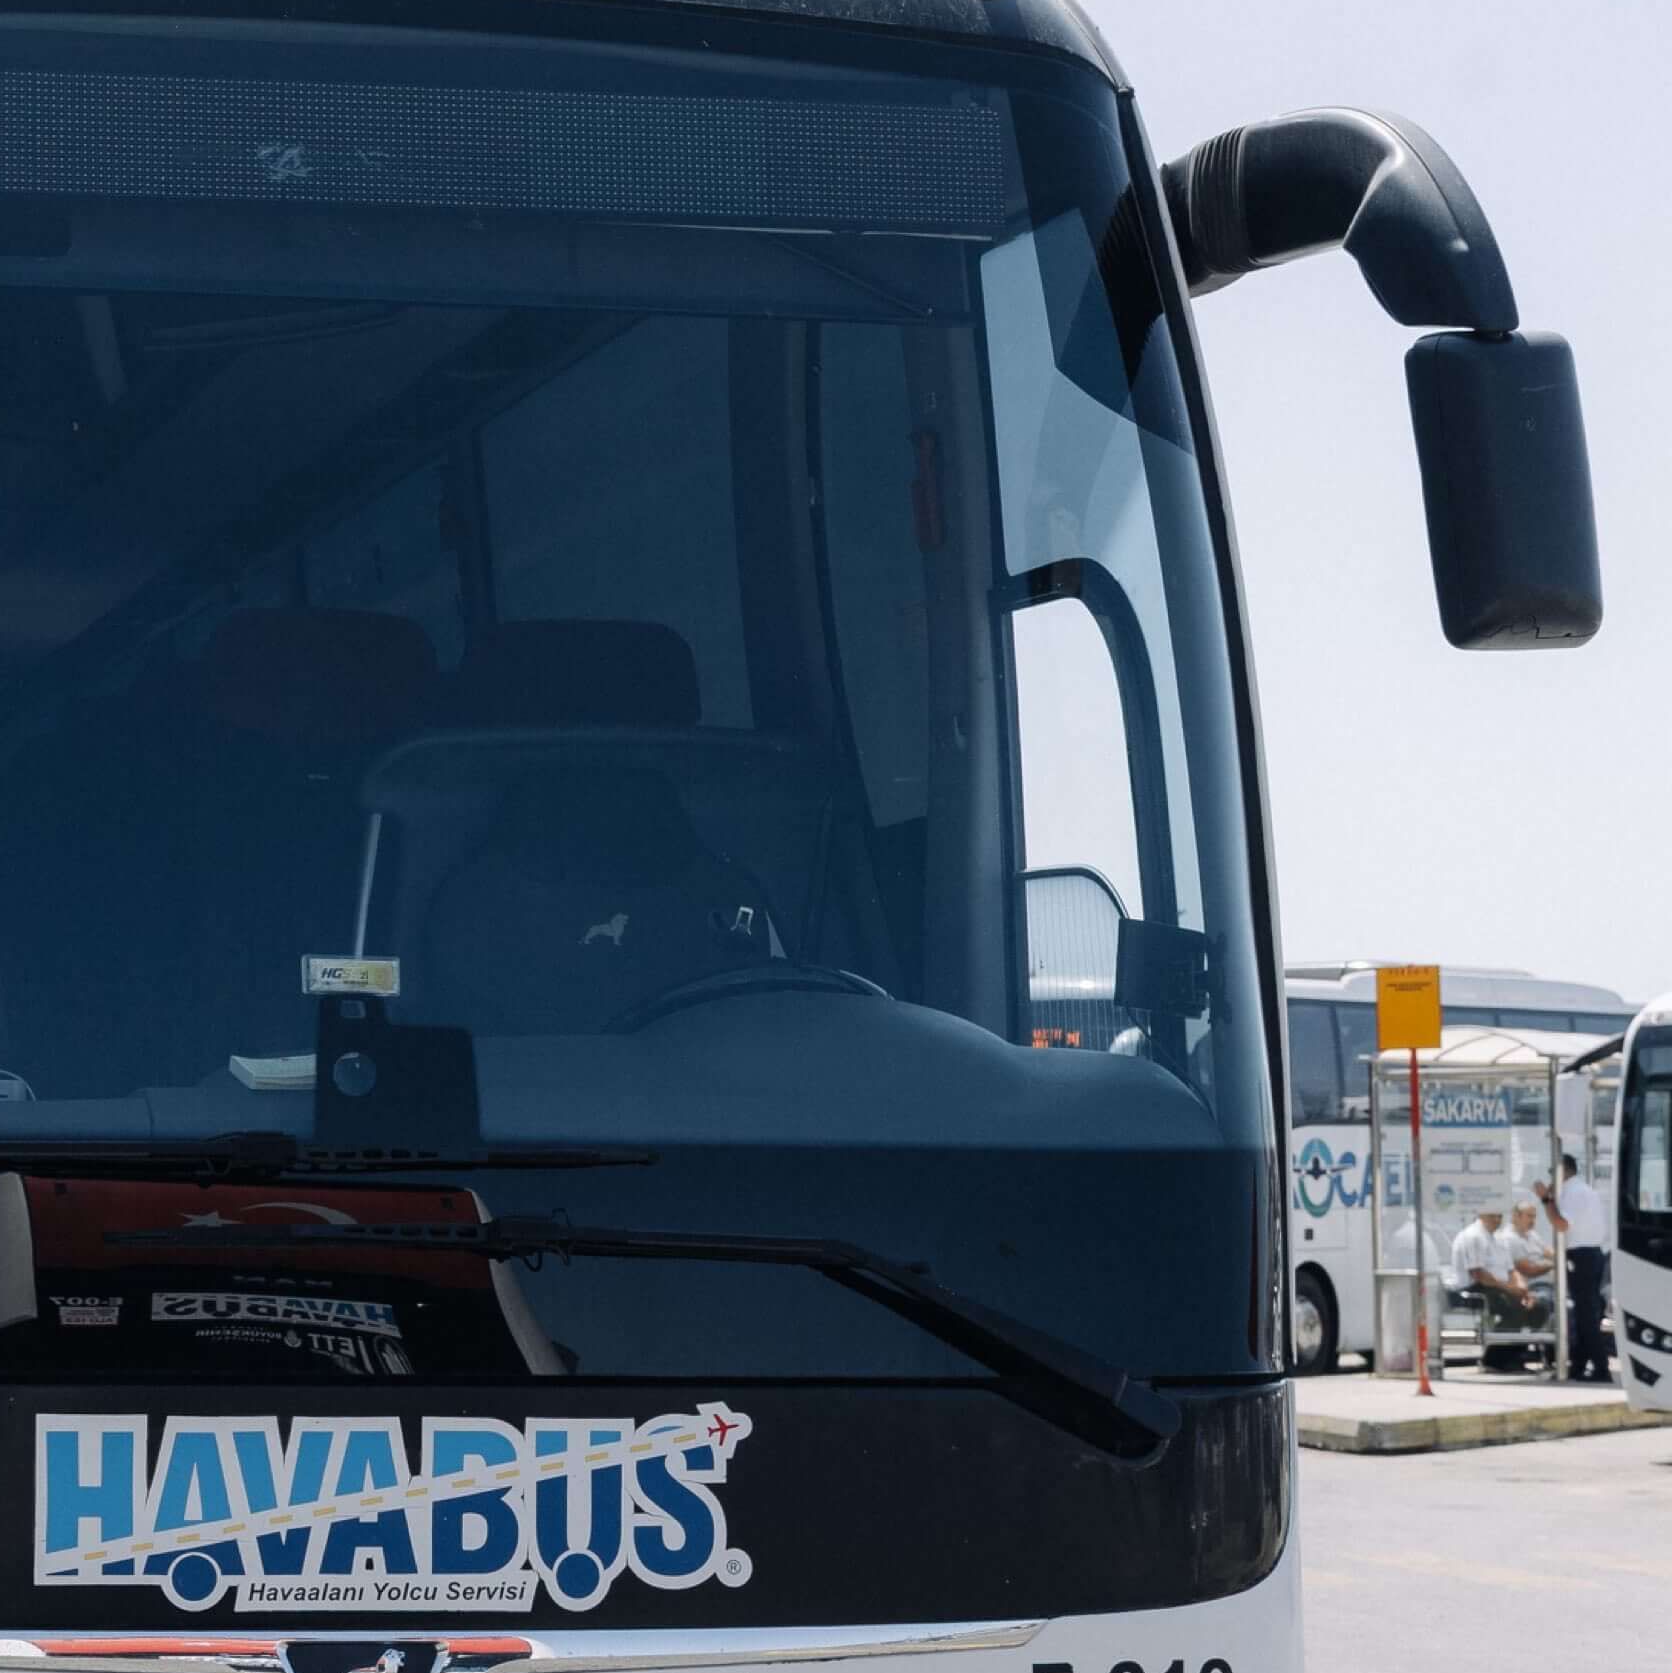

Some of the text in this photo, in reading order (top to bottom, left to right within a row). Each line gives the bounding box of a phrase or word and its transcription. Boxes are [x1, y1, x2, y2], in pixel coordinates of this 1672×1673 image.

[1424, 1097, 1508, 1123] SAKARYA
[45, 1425, 715, 1578] HAVABUS
[248, 1580, 528, 1602] Havaalanı Yolcu Servisi
